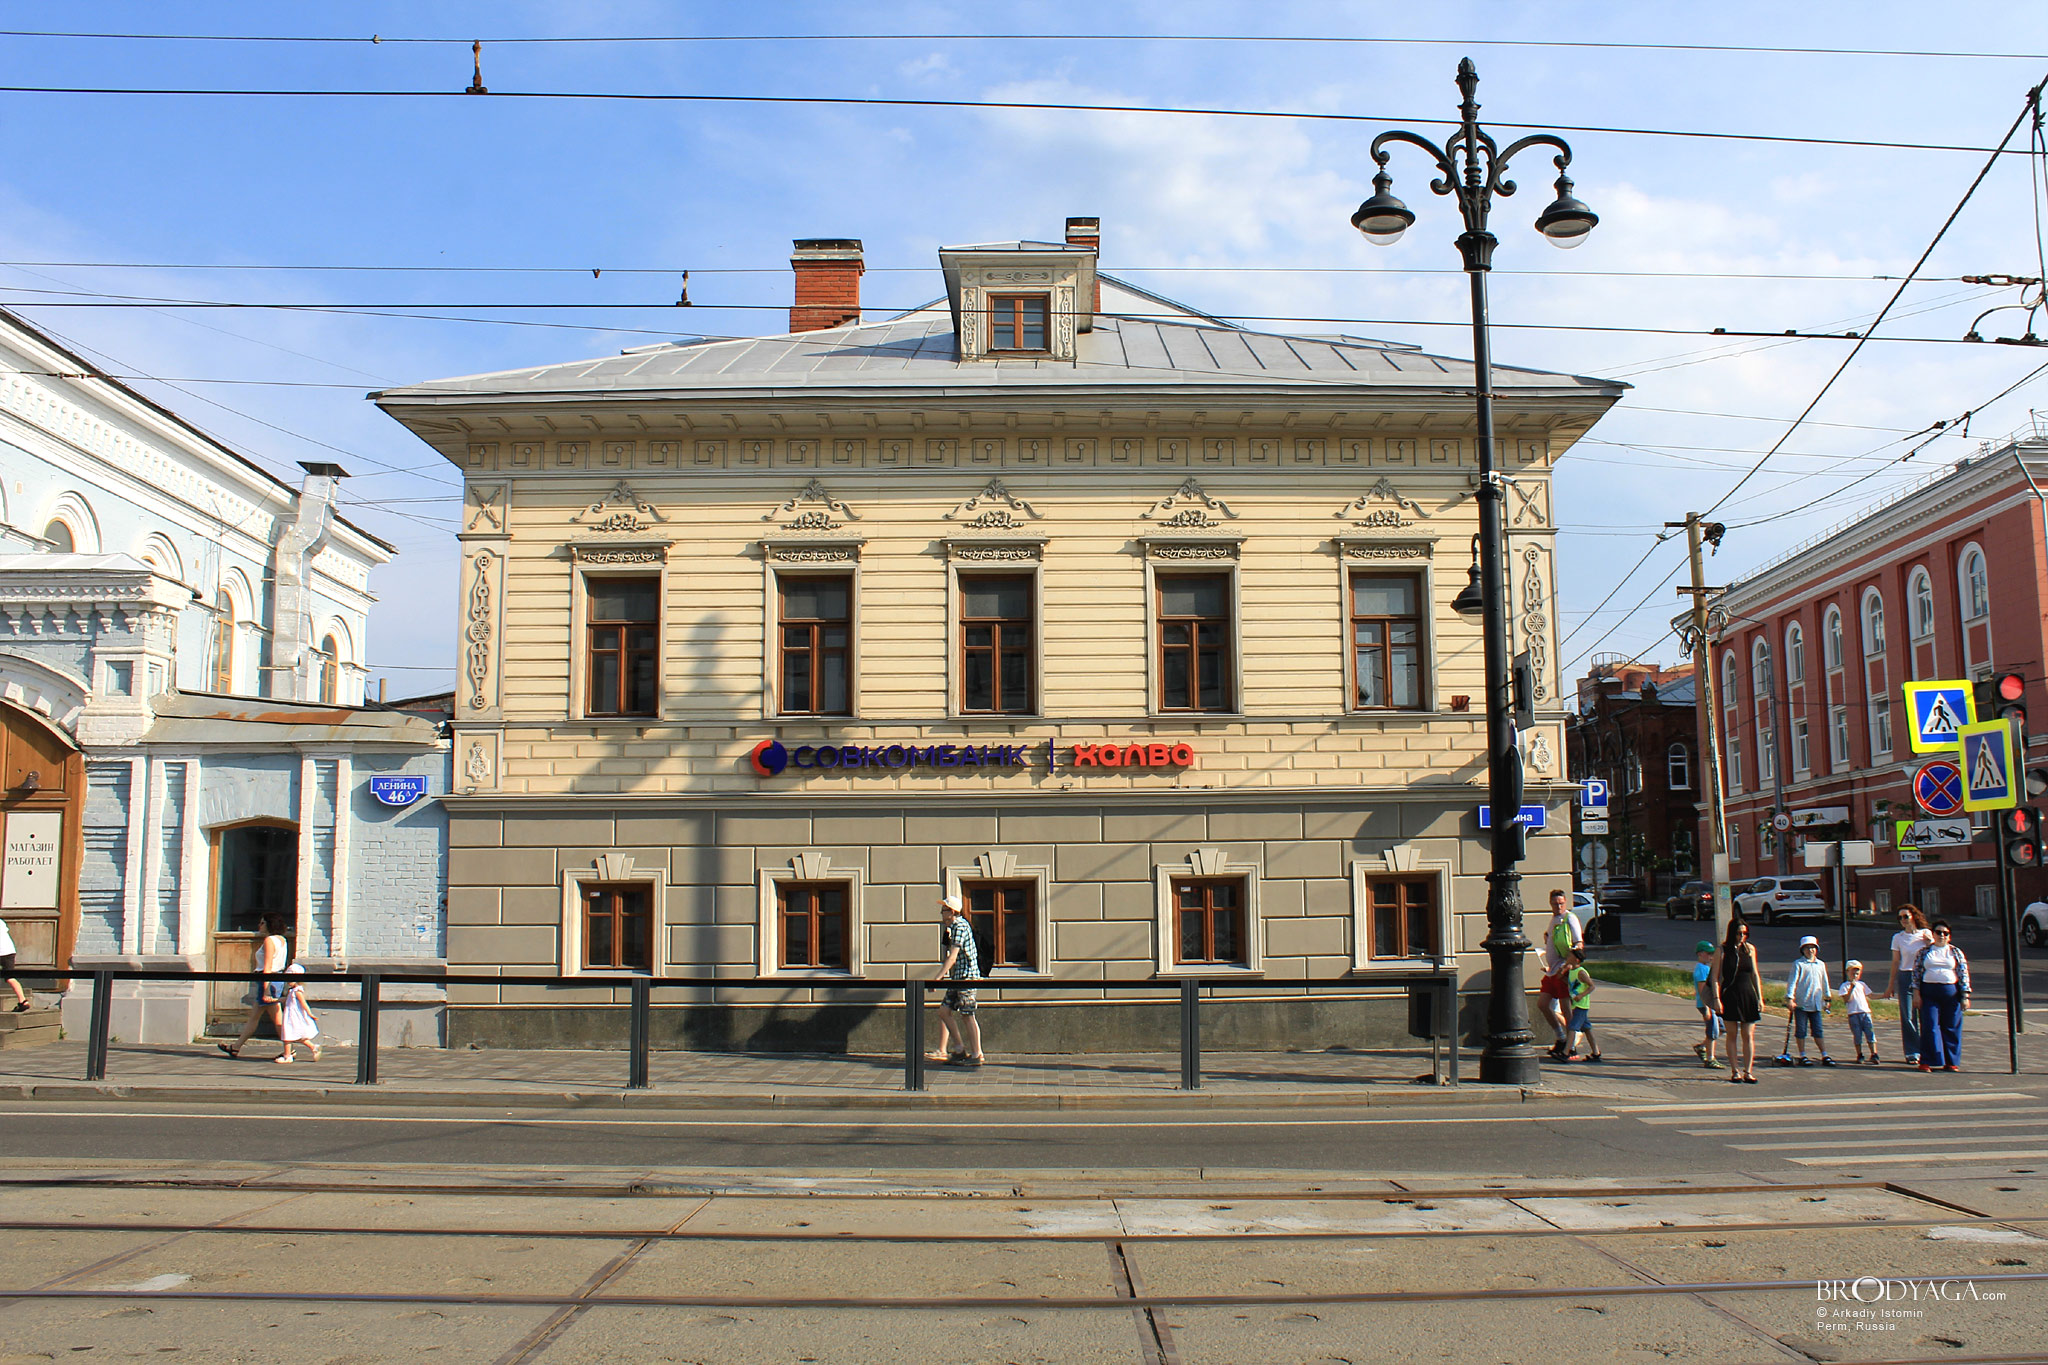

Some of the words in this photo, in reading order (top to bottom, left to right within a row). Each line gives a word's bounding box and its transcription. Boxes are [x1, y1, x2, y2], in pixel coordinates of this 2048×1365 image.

[794, 744, 1028, 769] СОВКОМБАНК
[377, 782, 417, 790] ЛЕНИНА
[1587, 782, 1604, 805] P
[1776, 818, 1787, 826] 40
[10, 843, 54, 852] МАГАЗИН
[2020, 844, 2033, 859] 13
[8, 857, 53, 866] РАБОТАЕТ
